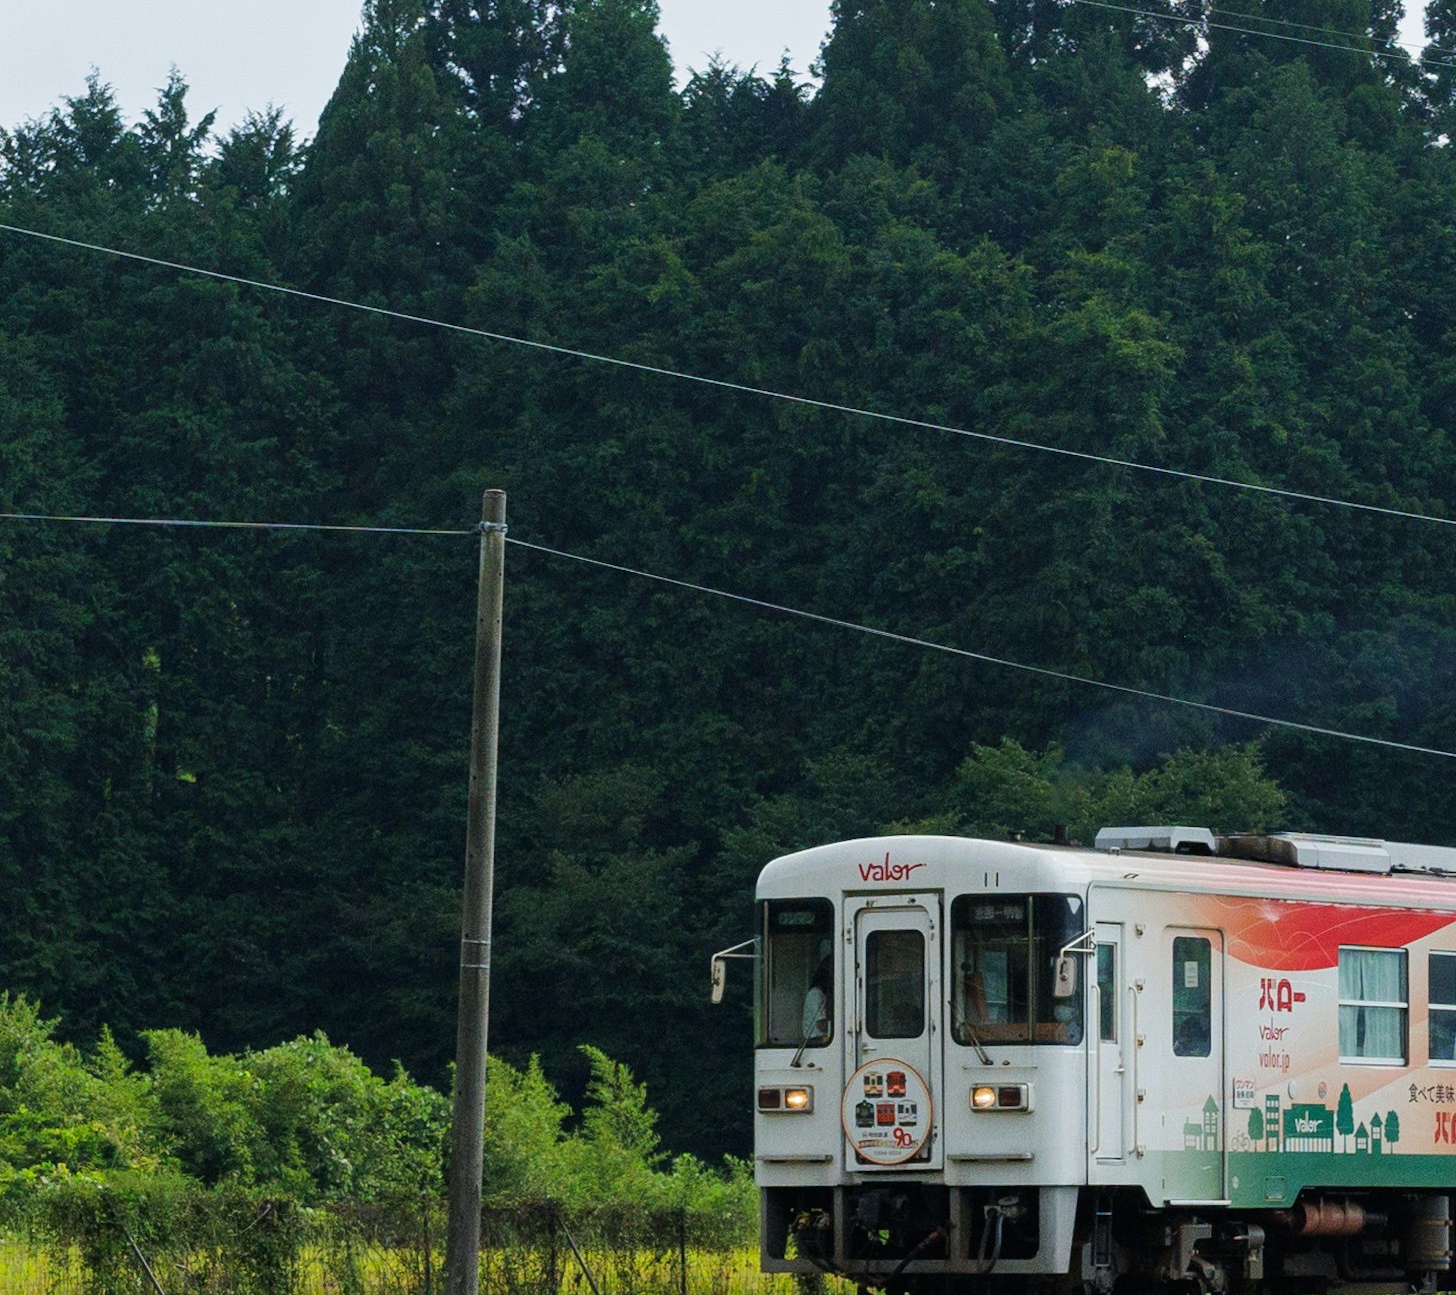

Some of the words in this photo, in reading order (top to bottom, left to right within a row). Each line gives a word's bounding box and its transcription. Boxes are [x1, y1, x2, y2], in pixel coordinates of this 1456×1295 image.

[859, 852, 926, 881] valor
[1259, 978, 1307, 1012] バロー
[1259, 1017, 1290, 1040] valor
[1259, 1045, 1290, 1074] valor.jp
[1295, 1111, 1324, 1134] valor
